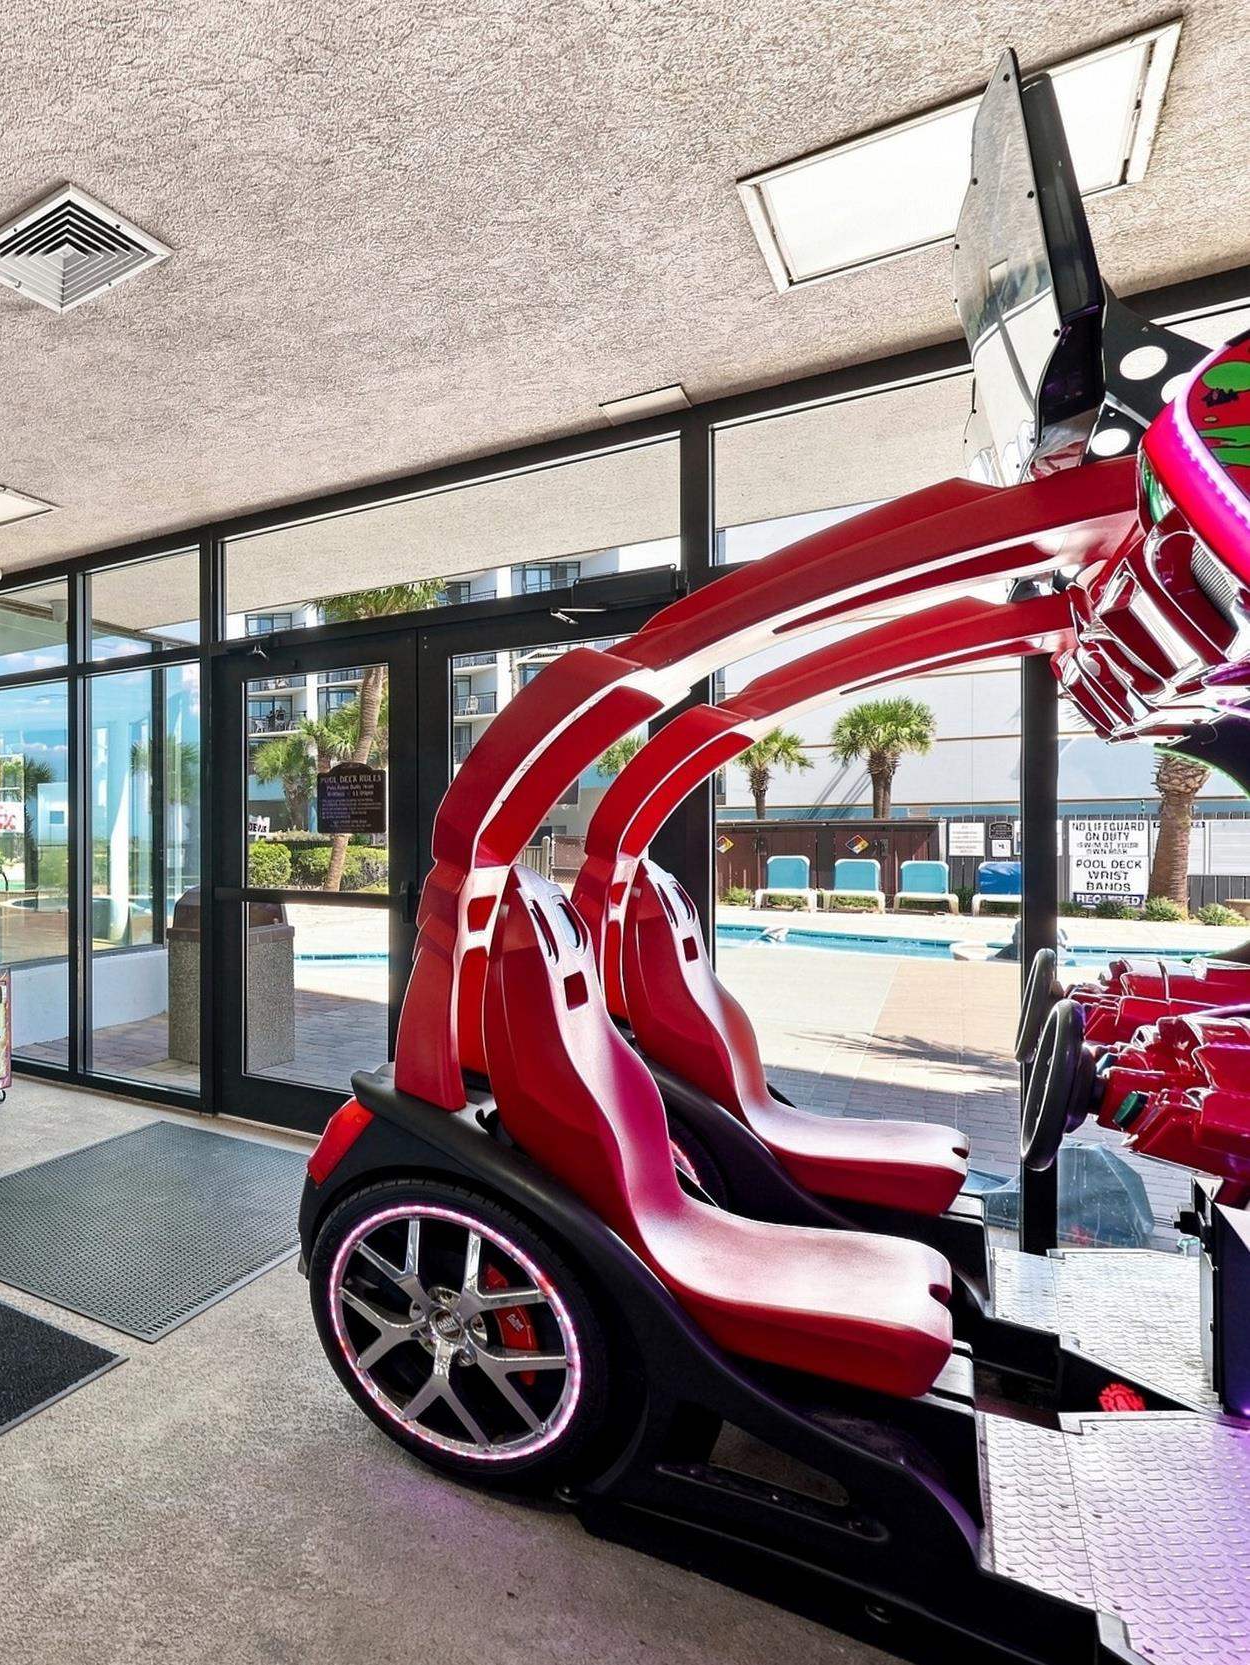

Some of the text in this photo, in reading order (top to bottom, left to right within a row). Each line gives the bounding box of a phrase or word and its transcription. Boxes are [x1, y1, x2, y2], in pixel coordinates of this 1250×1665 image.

[339, 775, 358, 783] DECK
[1072, 822, 1086, 832] NO
[1088, 822, 1145, 832] LIFEGUARD
[1085, 832, 1130, 841] ON DUTY
[1076, 859, 1142, 869] POOL DECK
[1088, 870, 1129, 881] WRIST
[1086, 882, 1131, 892] BANDS
